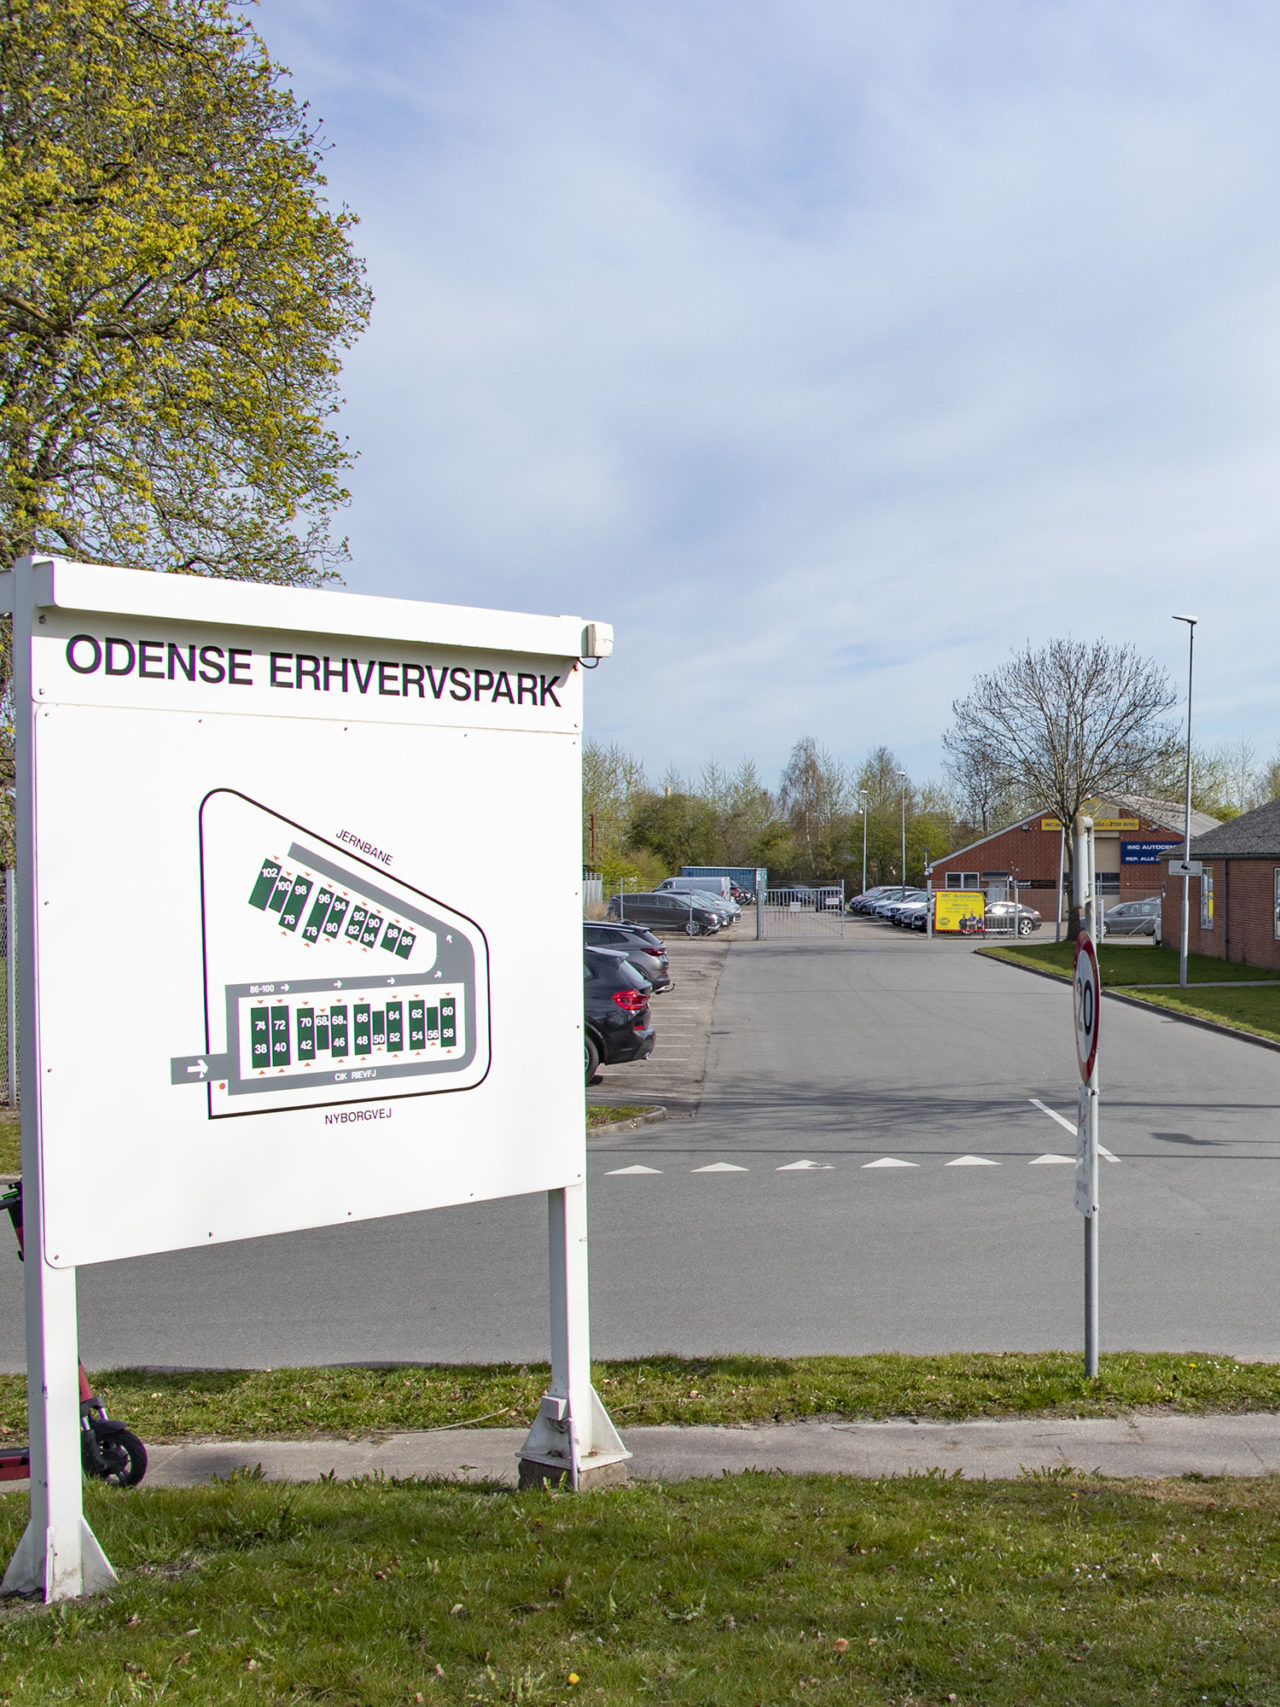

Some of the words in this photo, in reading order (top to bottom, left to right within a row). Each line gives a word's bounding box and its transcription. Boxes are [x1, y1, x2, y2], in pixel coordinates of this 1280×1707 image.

[66, 634, 253, 686] ODENSE
[270, 651, 562, 708] ERHVERVSPARK
[336, 829, 394, 866] JERNBANE
[261, 867, 278, 878] 102
[277, 881, 292, 891] 100
[294, 885, 307, 895] 98
[318, 894, 331, 904] 96
[334, 901, 346, 911] 94
[283, 915, 295, 925] 76
[353, 911, 365, 921] 92
[326, 923, 338, 932] 80
[368, 918, 380, 928] 90
[306, 926, 318, 936] 78
[347, 925, 360, 935] 82
[387, 928, 399, 938] 88
[363, 933, 375, 943] 84
[401, 936, 413, 946] 86
[250, 984, 275, 994] 86-100
[442, 1006, 454, 1016] 60
[1076, 976, 1093, 1036] 20
[356, 1013, 368, 1023] 66
[388, 1011, 400, 1020] 64
[411, 1009, 423, 1019] 62
[254, 1021, 266, 1031] 74
[273, 1020, 286, 1030] 72
[300, 1017, 312, 1028] 70
[389, 1033, 400, 1042] 52
[411, 1031, 423, 1040] 54
[427, 1029, 439, 1039] 56
[442, 1028, 454, 1038] 58
[333, 1037, 346, 1047] 46
[356, 1036, 368, 1045] 48
[373, 1034, 385, 1044] 50
[254, 1044, 267, 1054] 38
[273, 1042, 286, 1052] 40
[300, 1040, 312, 1050] 42
[325, 1108, 392, 1125] NYBORGVEJ
